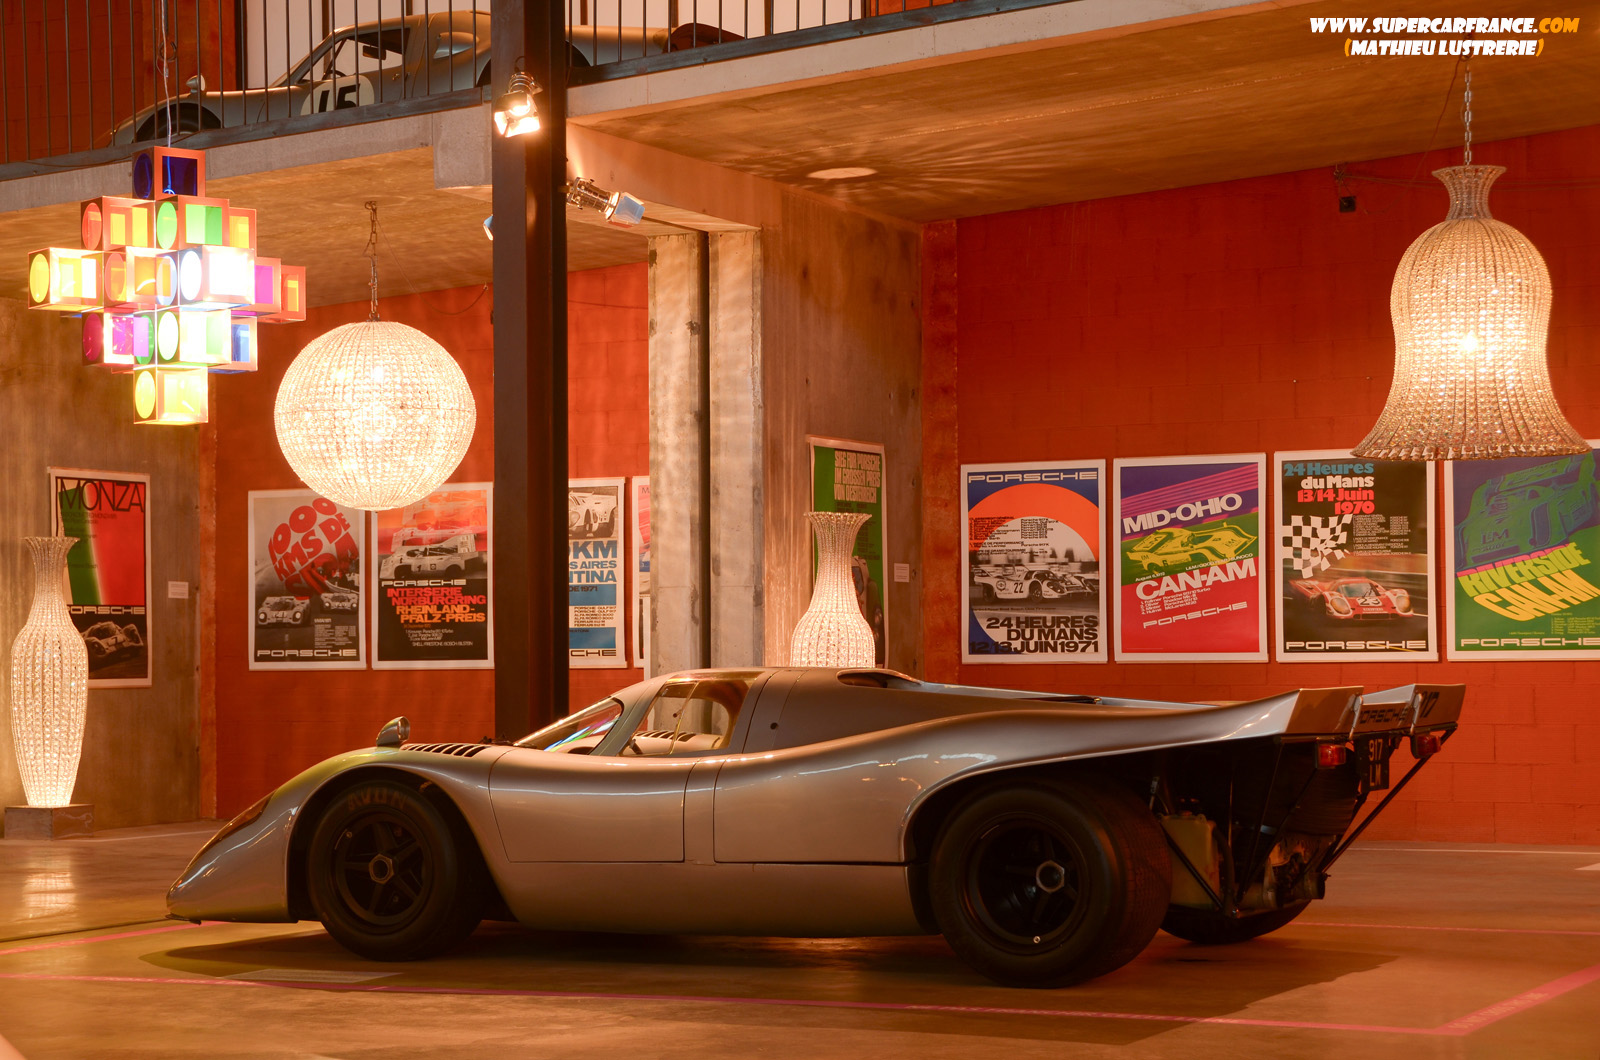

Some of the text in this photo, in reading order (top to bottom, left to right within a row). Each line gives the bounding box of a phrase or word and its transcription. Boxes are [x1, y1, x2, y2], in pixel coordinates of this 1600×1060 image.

[1283, 462, 1374, 477] 24 Heures
[968, 471, 1098, 484] PORSCHE
[1301, 475, 1374, 489] du Mans
[60, 478, 144, 512] MONZA
[1297, 488, 1374, 502] 13/14 Juin
[1123, 493, 1242, 534] MID-OHIO
[1334, 501, 1375, 515] 1970
[274, 512, 351, 582] KMS DE
[580, 560, 617, 569] AIRES
[1457, 542, 1591, 597] RIVERSIDE
[381, 579, 466, 587] PORSCHE
[569, 570, 617, 583] TINA
[1135, 558, 1257, 600] CAN-AM
[386, 587, 462, 597] INTERSERIE
[1013, 582, 1024, 594] 22
[400, 613, 486, 623] PFALZ-PREIS
[1143, 601, 1248, 629] PORSCHE
[986, 615, 1099, 629] 24 HEURES
[1007, 628, 1098, 641] DU MANS
[1058, 641, 1099, 653] 1971
[1286, 640, 1427, 650] PORSCHE
[1461, 637, 1600, 647] PORSCHE
[257, 649, 357, 657] PORSCHE
[1368, 738, 1383, 762] 917
